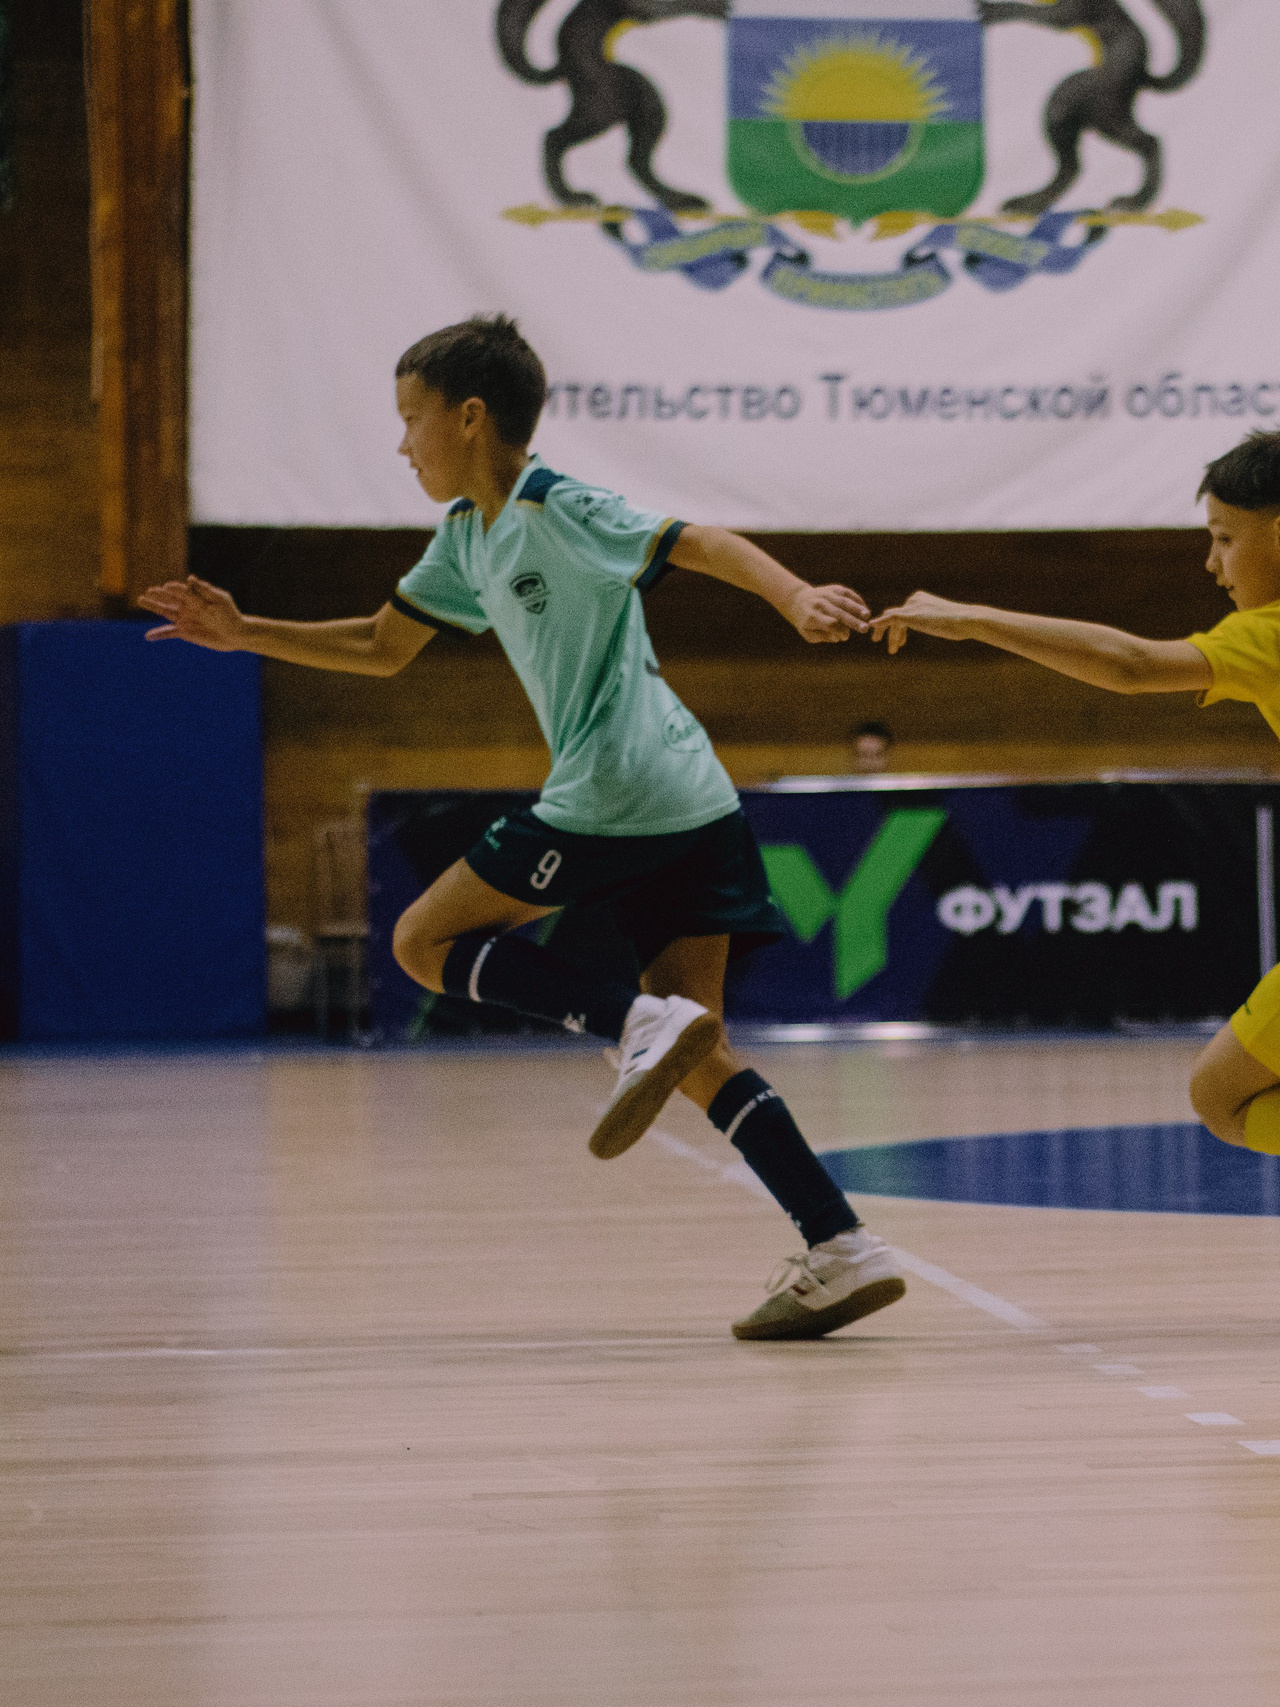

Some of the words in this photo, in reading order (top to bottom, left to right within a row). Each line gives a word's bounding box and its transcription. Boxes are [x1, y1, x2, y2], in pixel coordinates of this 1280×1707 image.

[818, 372, 1110, 420] Тюменской
[530, 849, 562, 890] 9
[937, 881, 1198, 935] ФУТЗАЛ
